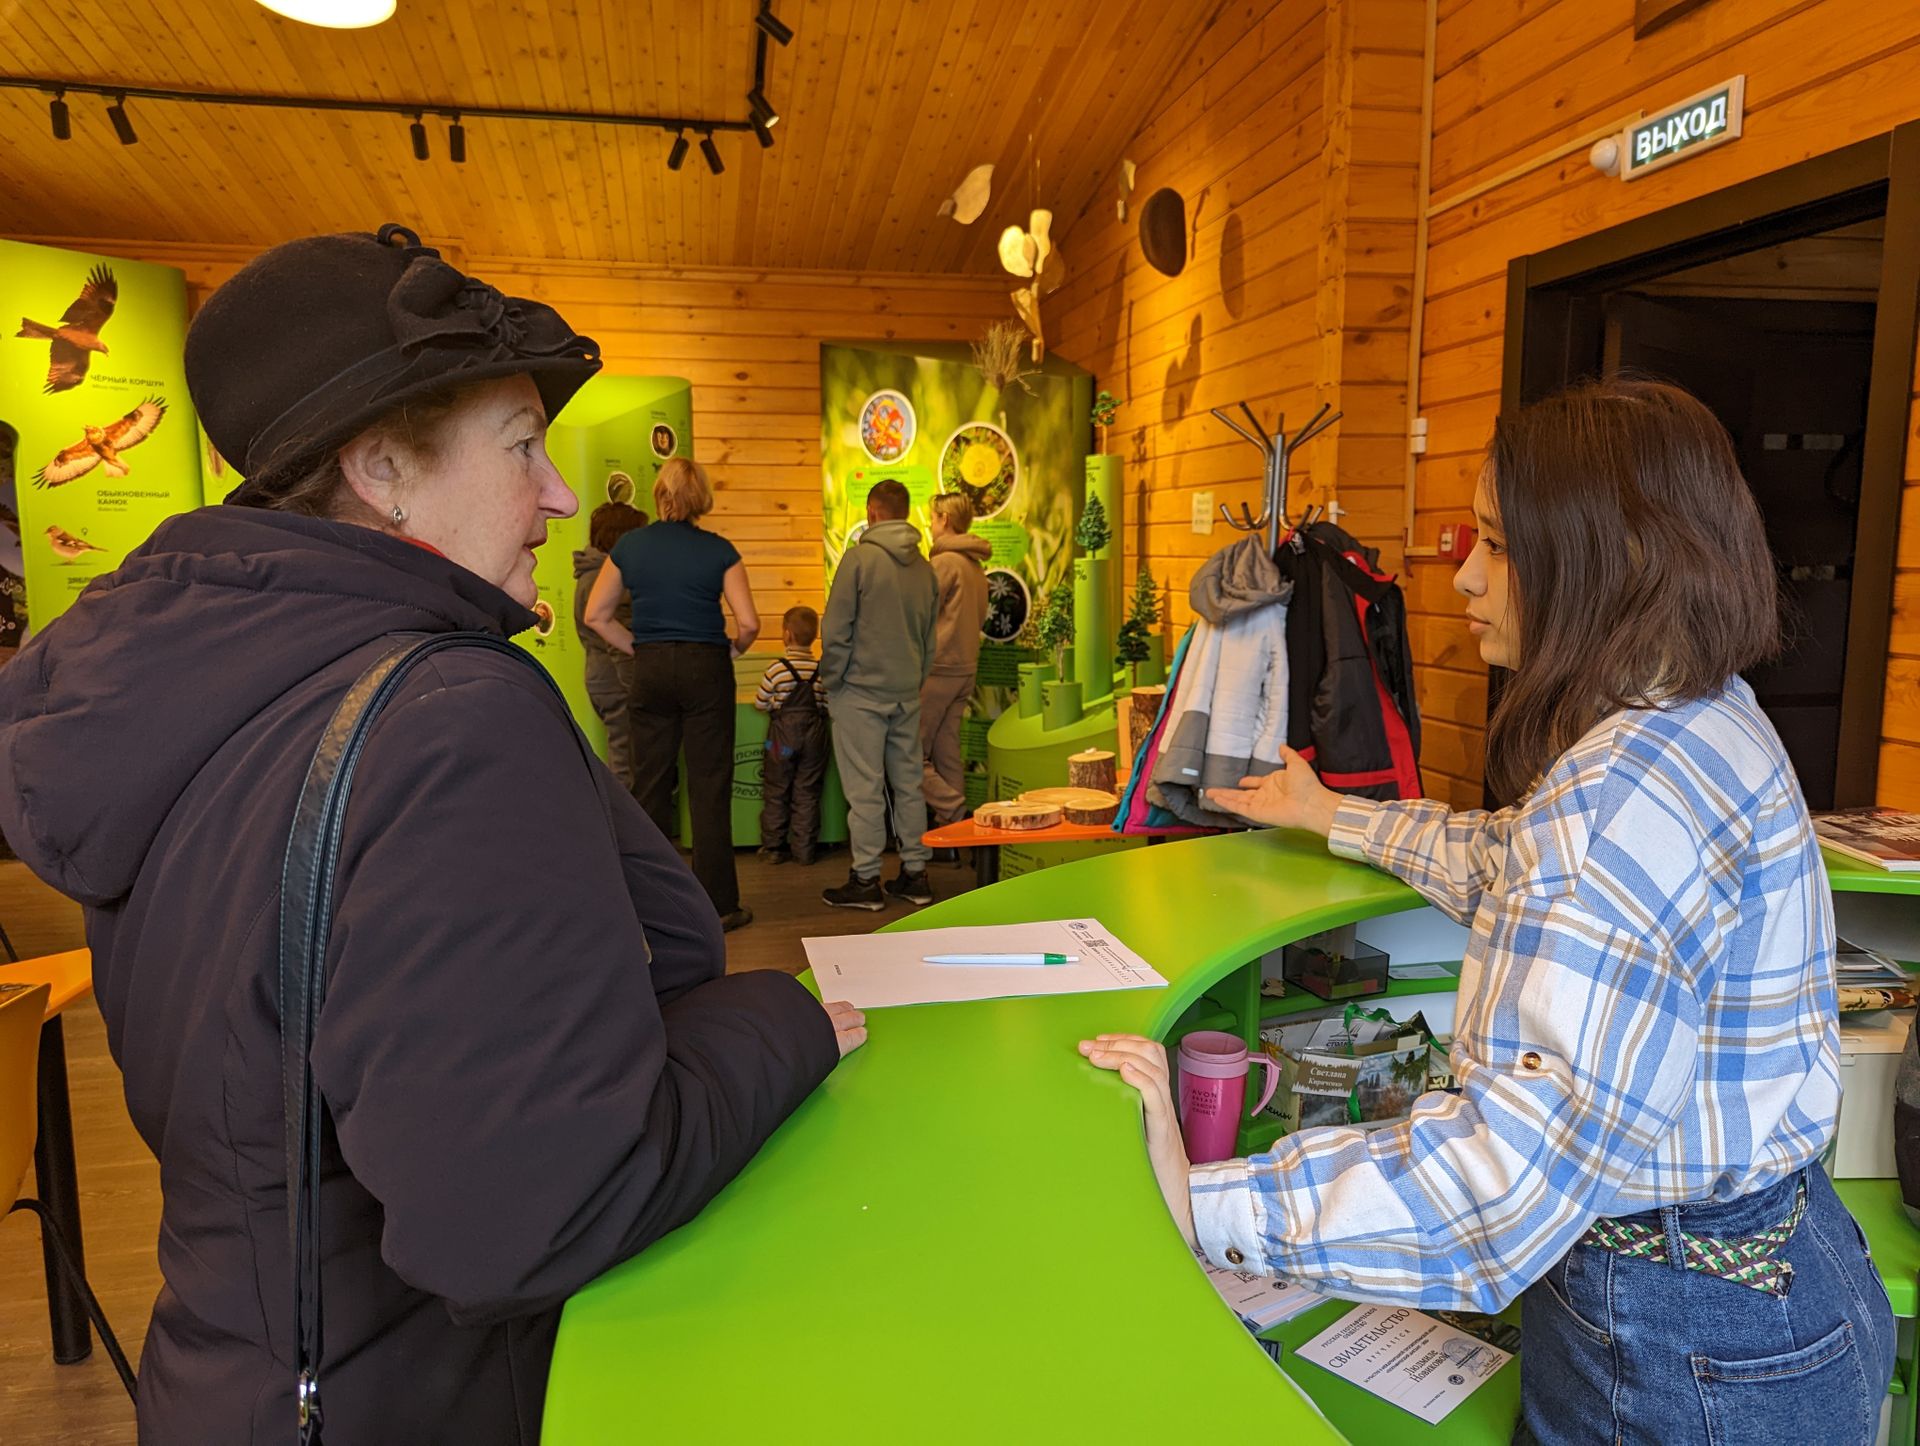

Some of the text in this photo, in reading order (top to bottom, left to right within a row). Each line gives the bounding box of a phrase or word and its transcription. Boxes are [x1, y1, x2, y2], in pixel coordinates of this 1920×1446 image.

[1635, 96, 1727, 161] ВЫХОД
[129, 378, 165, 387] КОРШУН
[96, 490, 170, 498] ОБЫКНОВЕННЫЙ
[1310, 1067, 1347, 1079] Светлана
[1192, 1089, 1217, 1098] AVON
[1328, 1308, 1410, 1368] СВИДЕТЕЛЬСТВО
